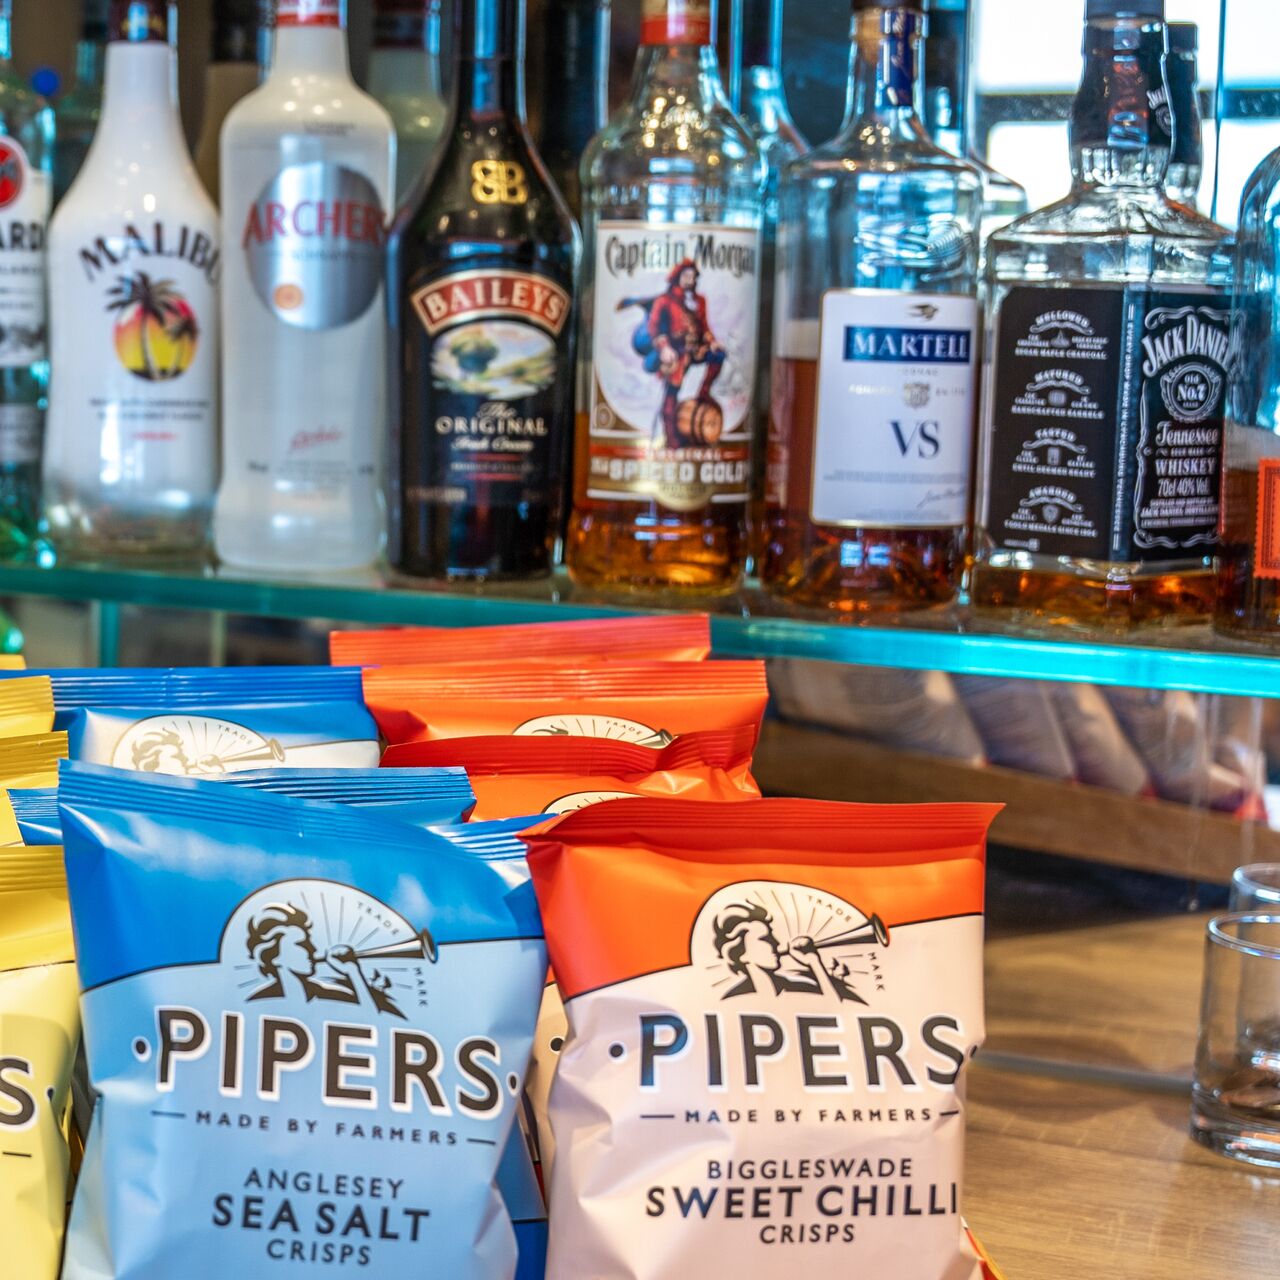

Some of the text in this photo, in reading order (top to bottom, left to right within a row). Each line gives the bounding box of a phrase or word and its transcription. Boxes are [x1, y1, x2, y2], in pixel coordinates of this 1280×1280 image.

[605, 233, 686, 278] Captain
[423, 277, 563, 320] BAILEYS
[852, 332, 968, 359] MARTELL
[1141, 323, 1185, 377] JACK
[1177, 383, 1206, 402] No.7
[434, 416, 548, 436] ORIGINAL
[890, 419, 941, 460] VS
[1155, 420, 1219, 447] Tennessee
[1154, 457, 1216, 477] WHISKEY
[1177, 477, 1196, 497] 40%
[357, 901, 400, 937] TRADE
[808, 895, 852, 922] TRADE
[867, 951, 886, 991] MARK
[154, 1006, 505, 1116] PIPERS
[638, 1013, 964, 1089] PIPERS
[195, 1110, 458, 1145] MADE BY FARMERS
[685, 1107, 932, 1123] MADE BY FARMERS
[244, 1167, 405, 1199] ANGLESEY
[707, 1158, 913, 1181] BIGGLESWADE
[645, 1182, 958, 1220] SWEET CHILLI
[212, 1194, 431, 1242] SEA SALT
[759, 1224, 856, 1246] CRISPS
[266, 1239, 372, 1267] CRISPS
